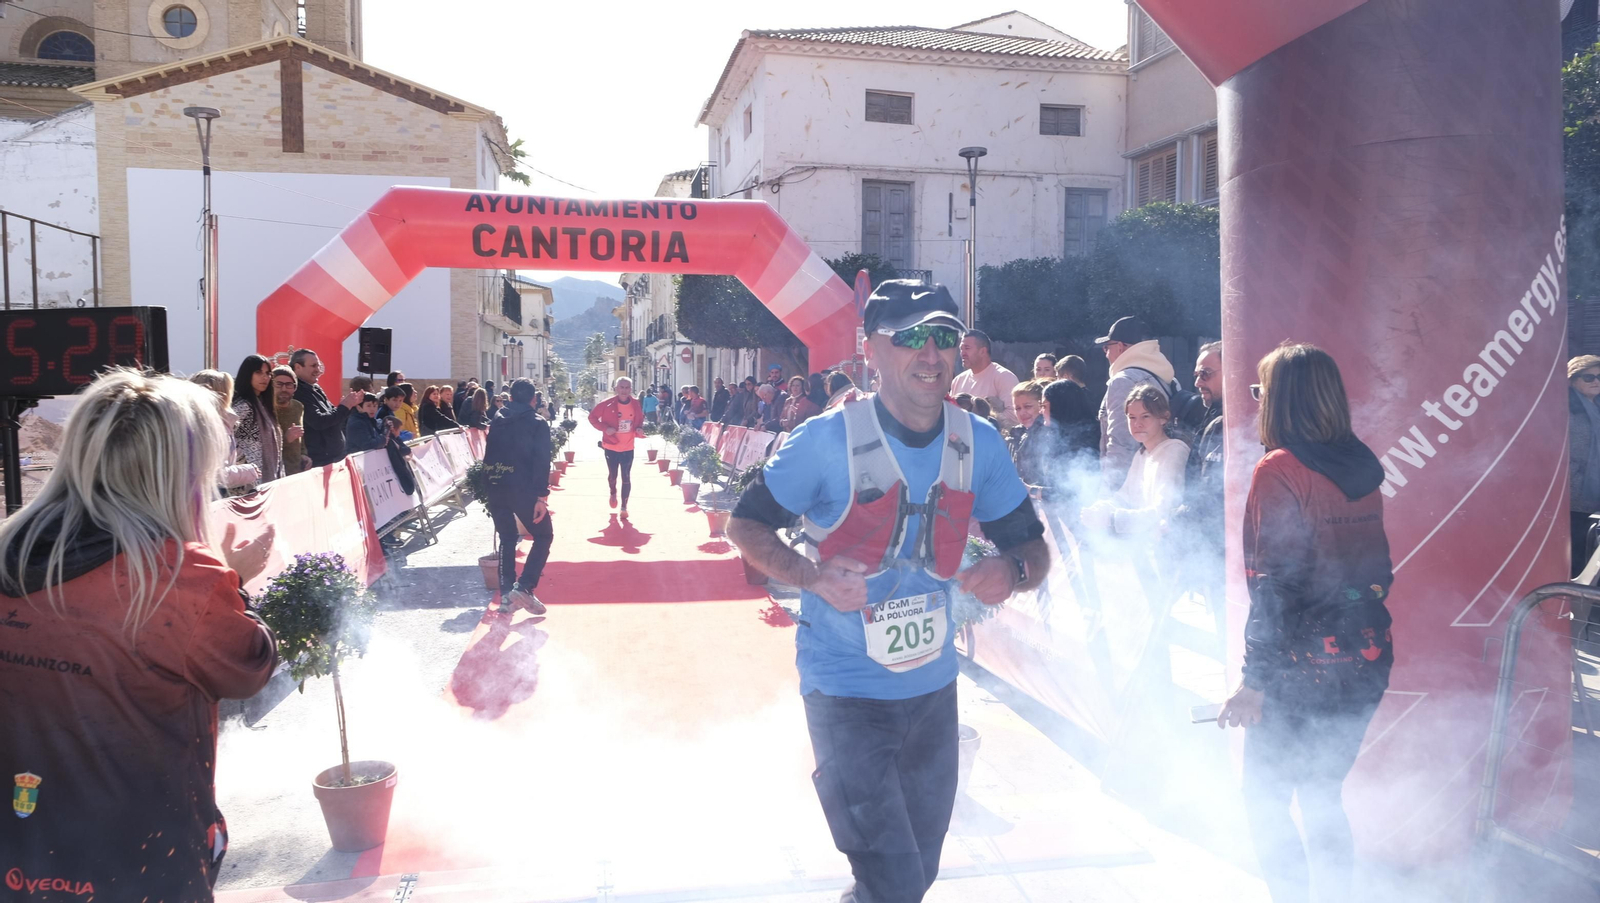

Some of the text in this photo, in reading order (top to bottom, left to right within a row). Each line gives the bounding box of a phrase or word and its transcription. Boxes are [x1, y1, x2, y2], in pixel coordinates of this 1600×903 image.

[465, 194, 698, 220] AYUNTAMIENTO
[472, 223, 690, 263] CANTORIA
[1378, 213, 1567, 499] ww.teamergy.es
[888, 598, 910, 610] CxM
[874, 607, 924, 623] LA PÓLVORA
[885, 617, 935, 654] 205
[1310, 656, 1354, 665] COSENTINO
[26, 878, 94, 894] VEOLIA
